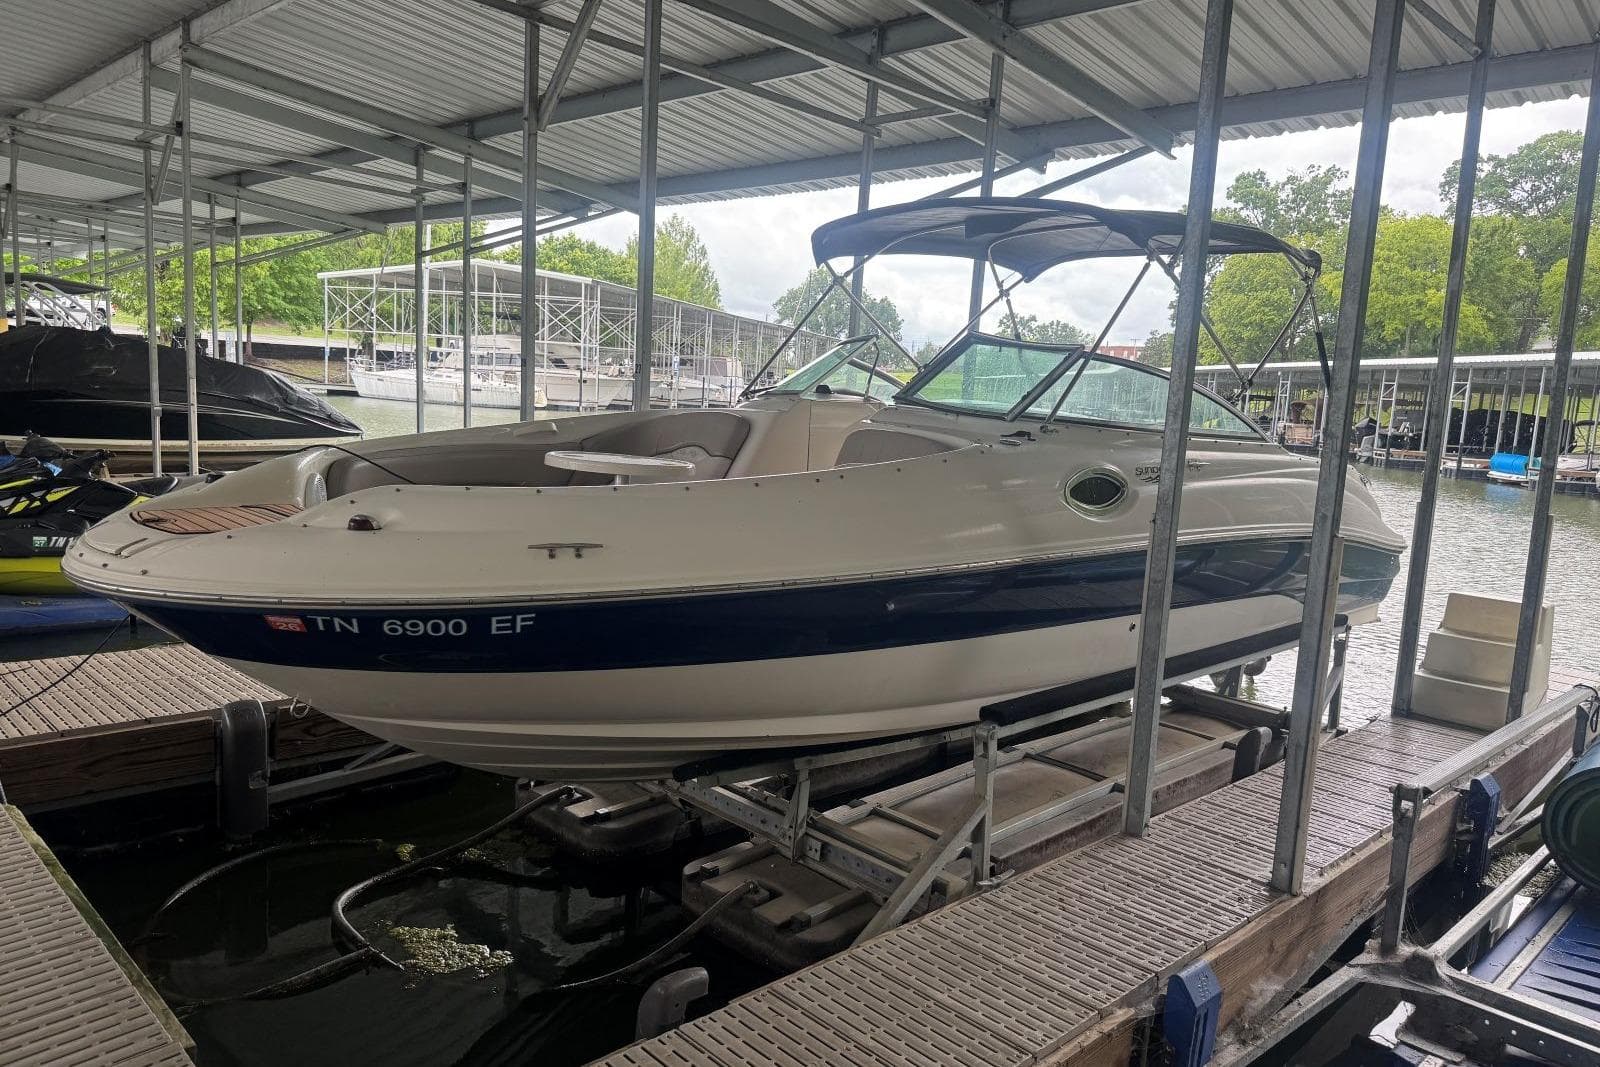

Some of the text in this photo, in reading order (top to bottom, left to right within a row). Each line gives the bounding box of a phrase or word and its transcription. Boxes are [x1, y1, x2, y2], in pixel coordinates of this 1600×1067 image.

[48, 536, 67, 547] TN
[307, 613, 536, 636] TN 6900 EF
